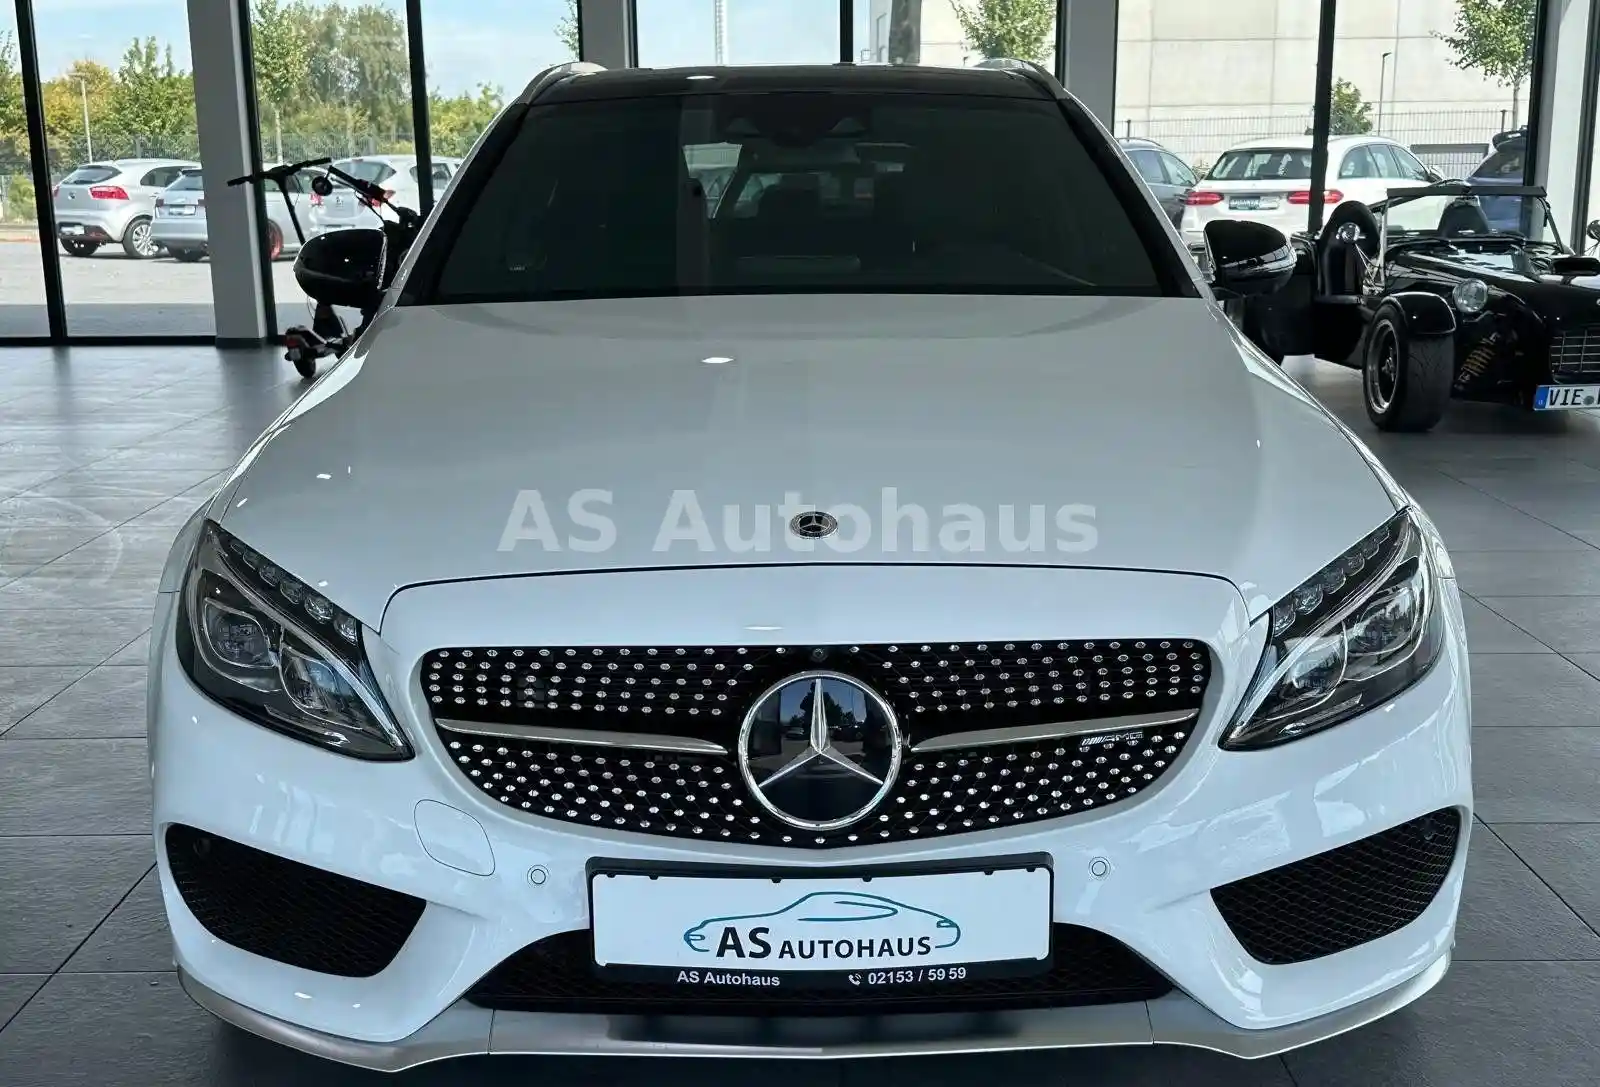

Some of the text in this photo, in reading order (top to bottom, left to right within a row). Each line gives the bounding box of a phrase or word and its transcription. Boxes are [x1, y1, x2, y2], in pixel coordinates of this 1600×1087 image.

[1549, 389, 1583, 406] VIE
[716, 926, 931, 959] AS AUTOHAUS
[677, 970, 781, 986] AS Autohaus
[867, 970, 914, 985] 02153
